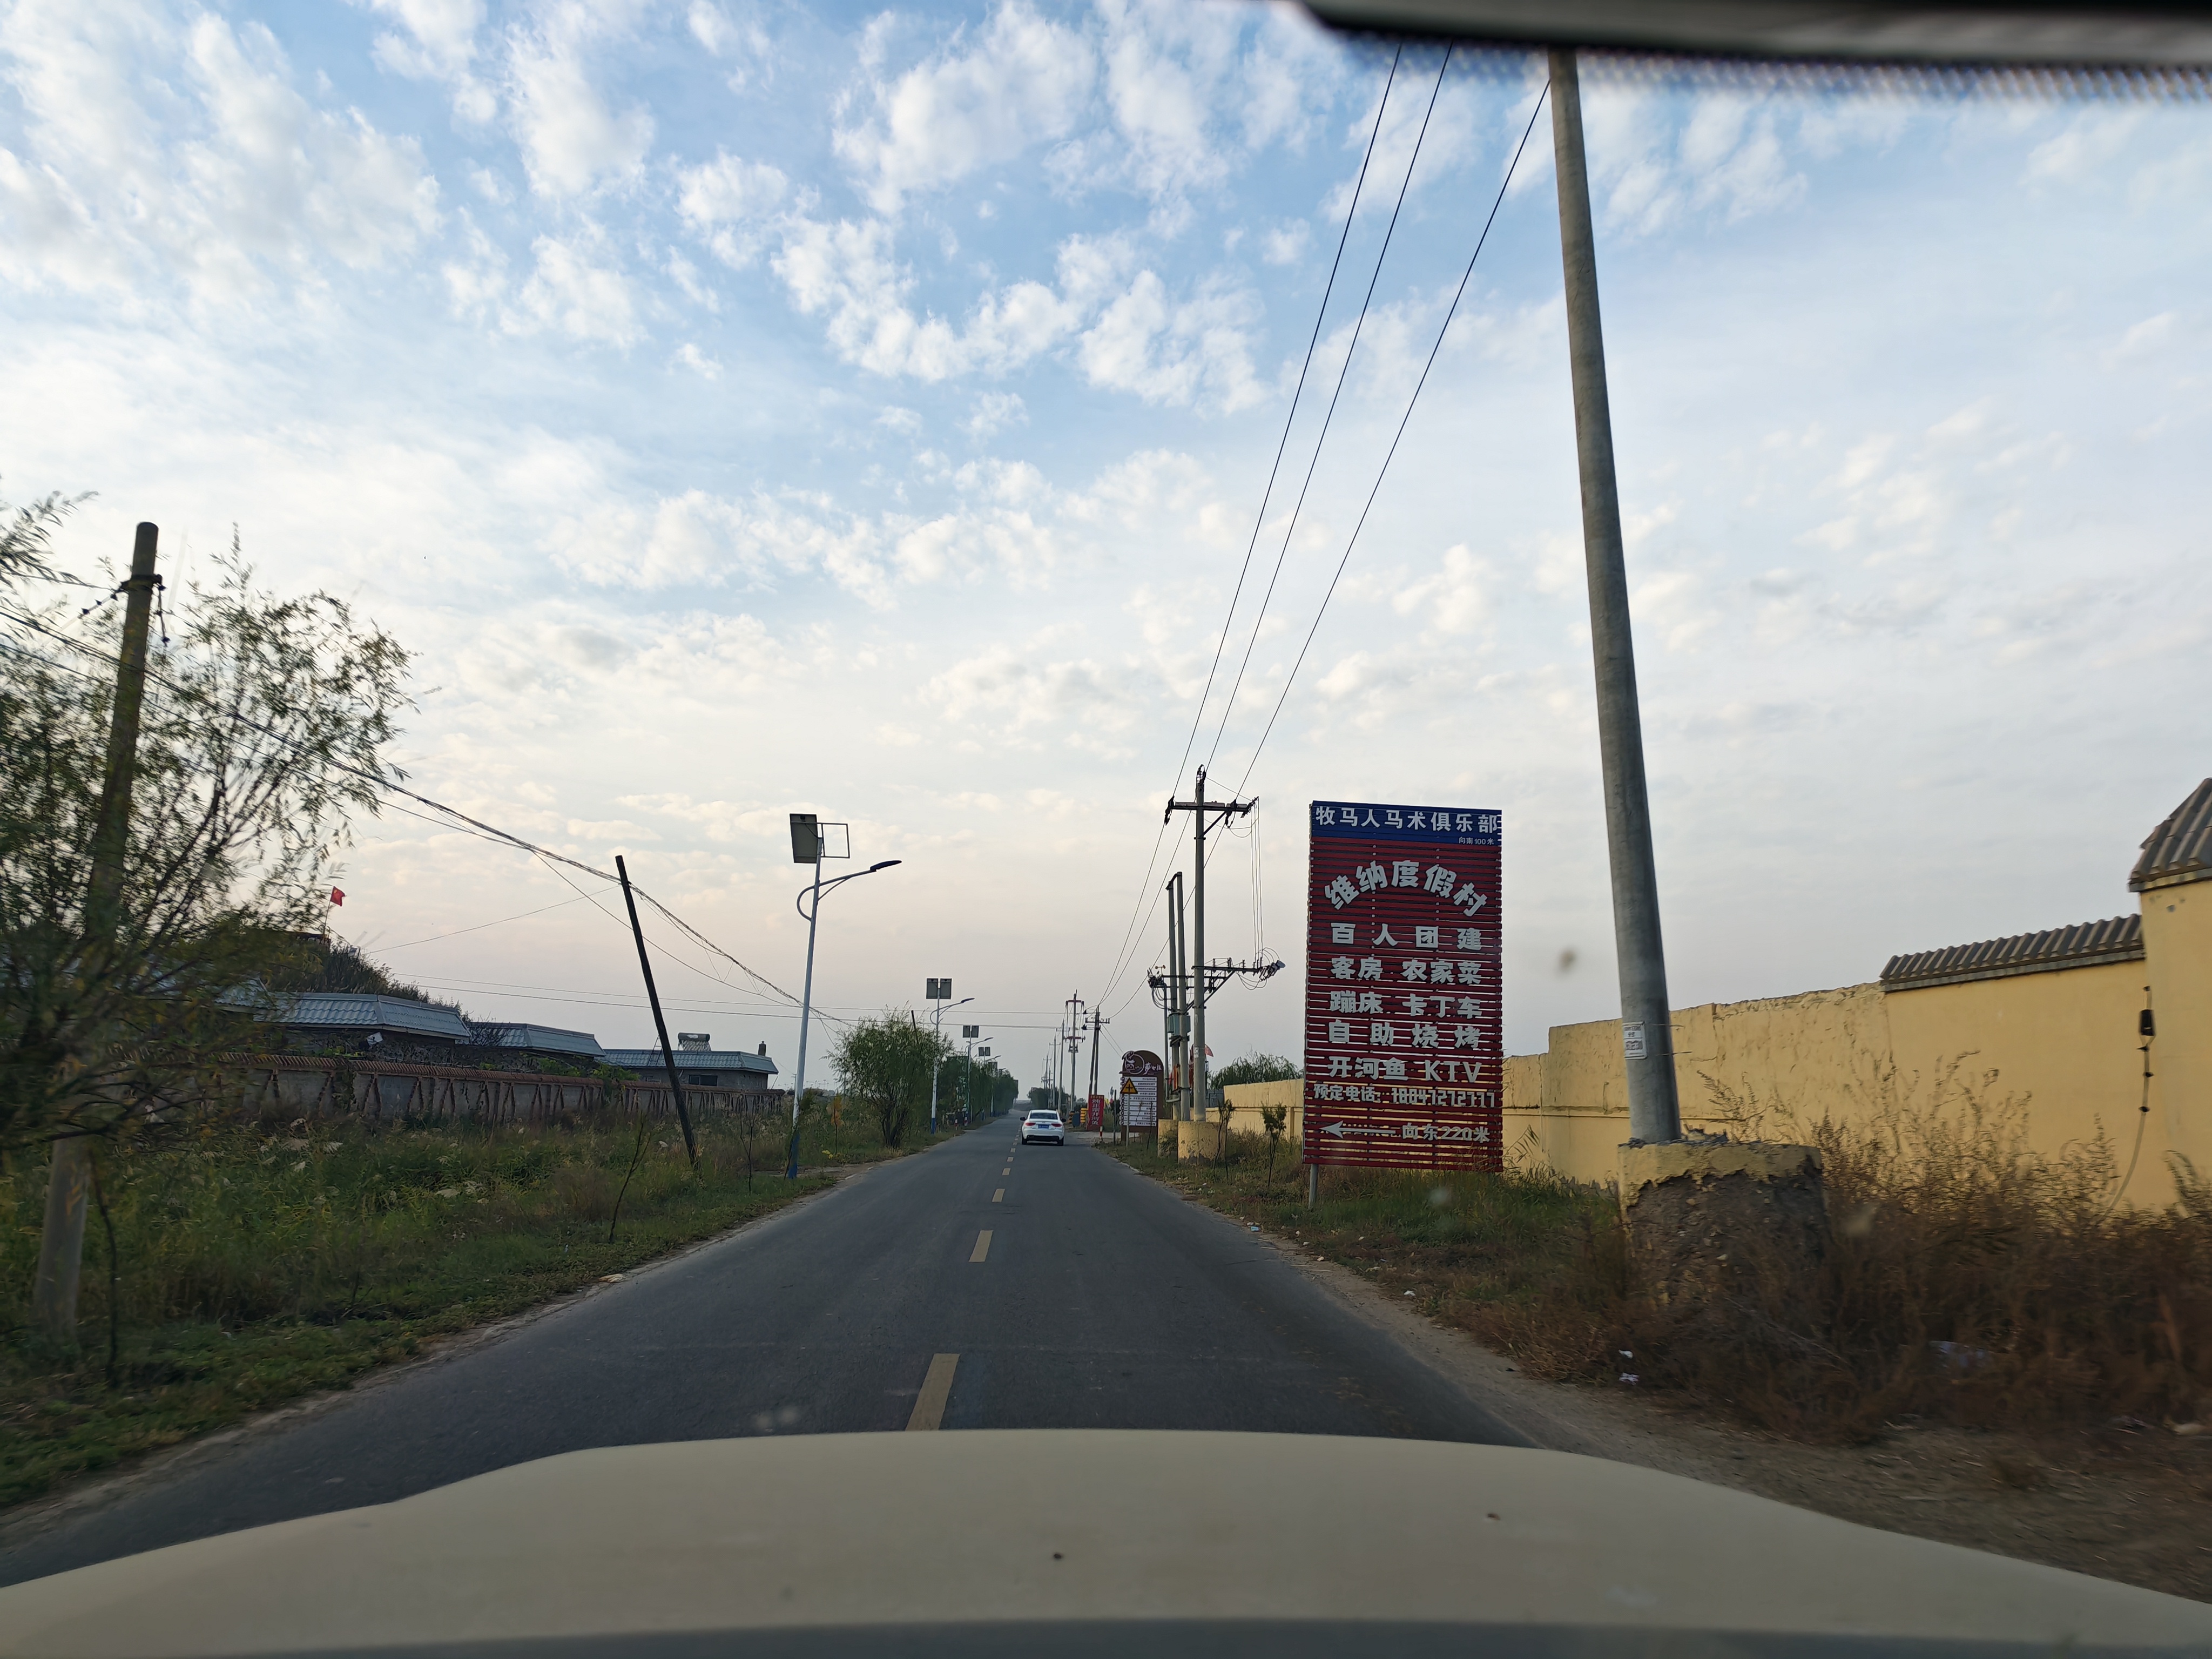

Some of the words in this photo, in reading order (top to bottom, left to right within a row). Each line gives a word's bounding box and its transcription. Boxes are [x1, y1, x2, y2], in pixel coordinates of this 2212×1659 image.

[1316, 806, 1498, 833] 牧马人马术俱乐部
[1459, 837, 1494, 845] 向南100米
[1325, 860, 1487, 916] 维纳度假村
[1331, 922, 1482, 950] 百人团建
[1331, 956, 1383, 980] 客房
[1402, 959, 1482, 984] 农家菜
[1330, 990, 1384, 1014] 蹦床
[1402, 993, 1482, 1019] 卡丁车
[1328, 1019, 1481, 1048] 自助烧烤
[1327, 1056, 1408, 1081] 开河鱼
[1424, 1059, 1482, 1083] KTV
[1402, 1122, 1490, 1143] 向东220米
